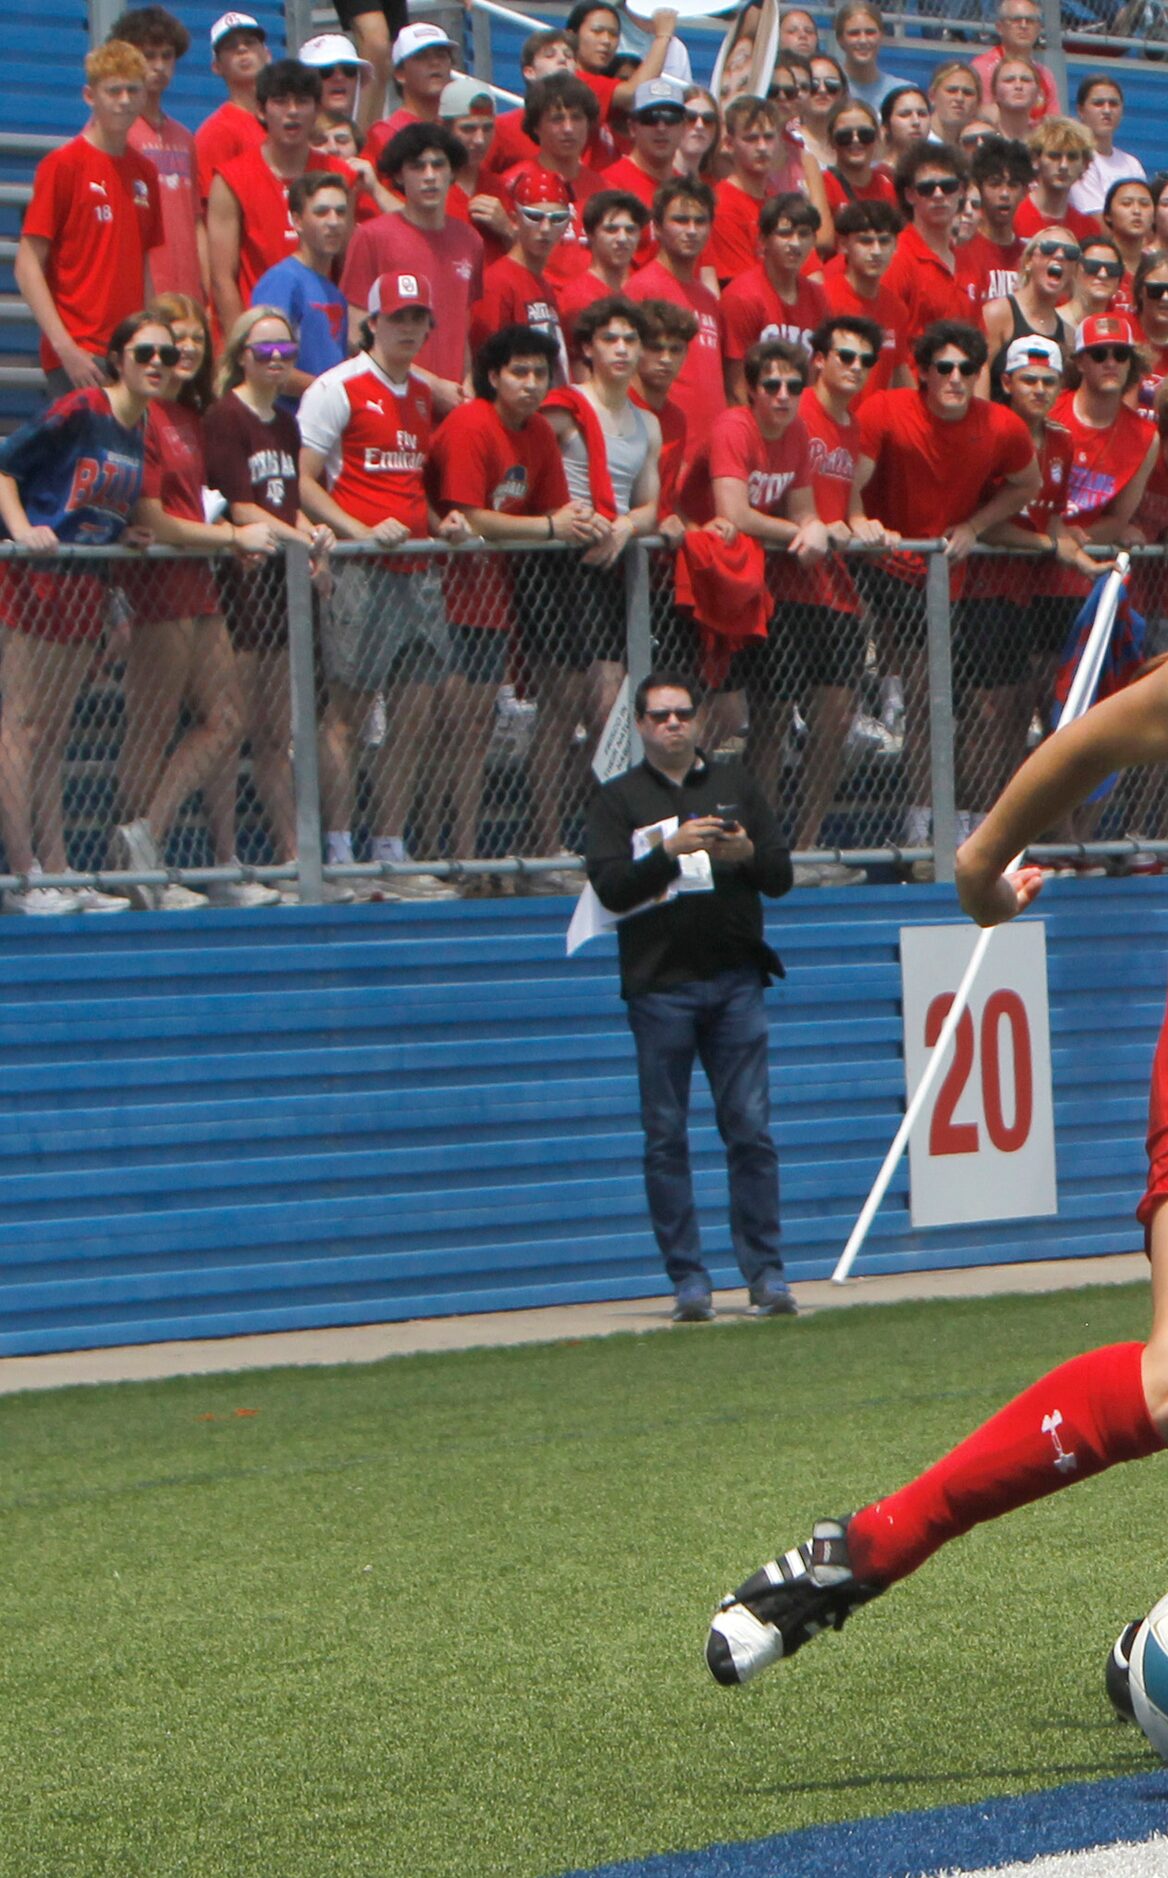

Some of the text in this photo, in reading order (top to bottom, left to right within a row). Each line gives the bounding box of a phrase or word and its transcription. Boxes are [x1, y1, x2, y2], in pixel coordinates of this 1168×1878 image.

[94, 204, 114, 223] 18
[396, 430, 418, 450] Fly
[925, 988, 1034, 1157] 20
